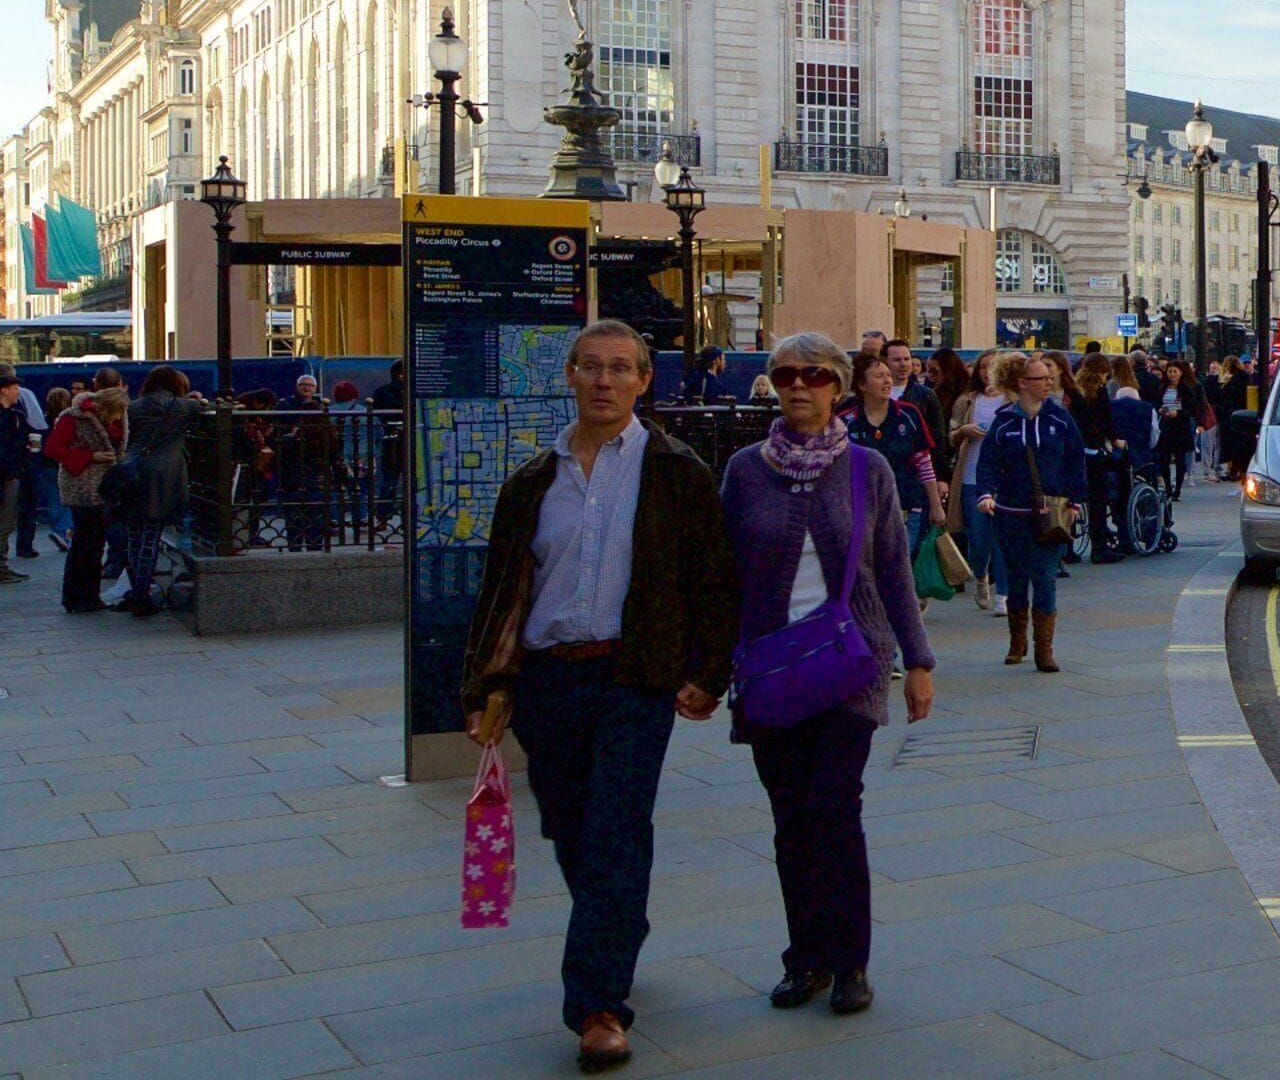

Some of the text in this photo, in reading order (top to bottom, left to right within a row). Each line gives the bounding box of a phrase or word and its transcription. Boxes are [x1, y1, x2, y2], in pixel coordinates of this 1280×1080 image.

[416, 228, 464, 237] WEST END
[416, 237, 489, 247] Piccadilly Circus
[281, 250, 351, 259] PUBLIC SUBWAY
[600, 253, 634, 261] SUBWAY
